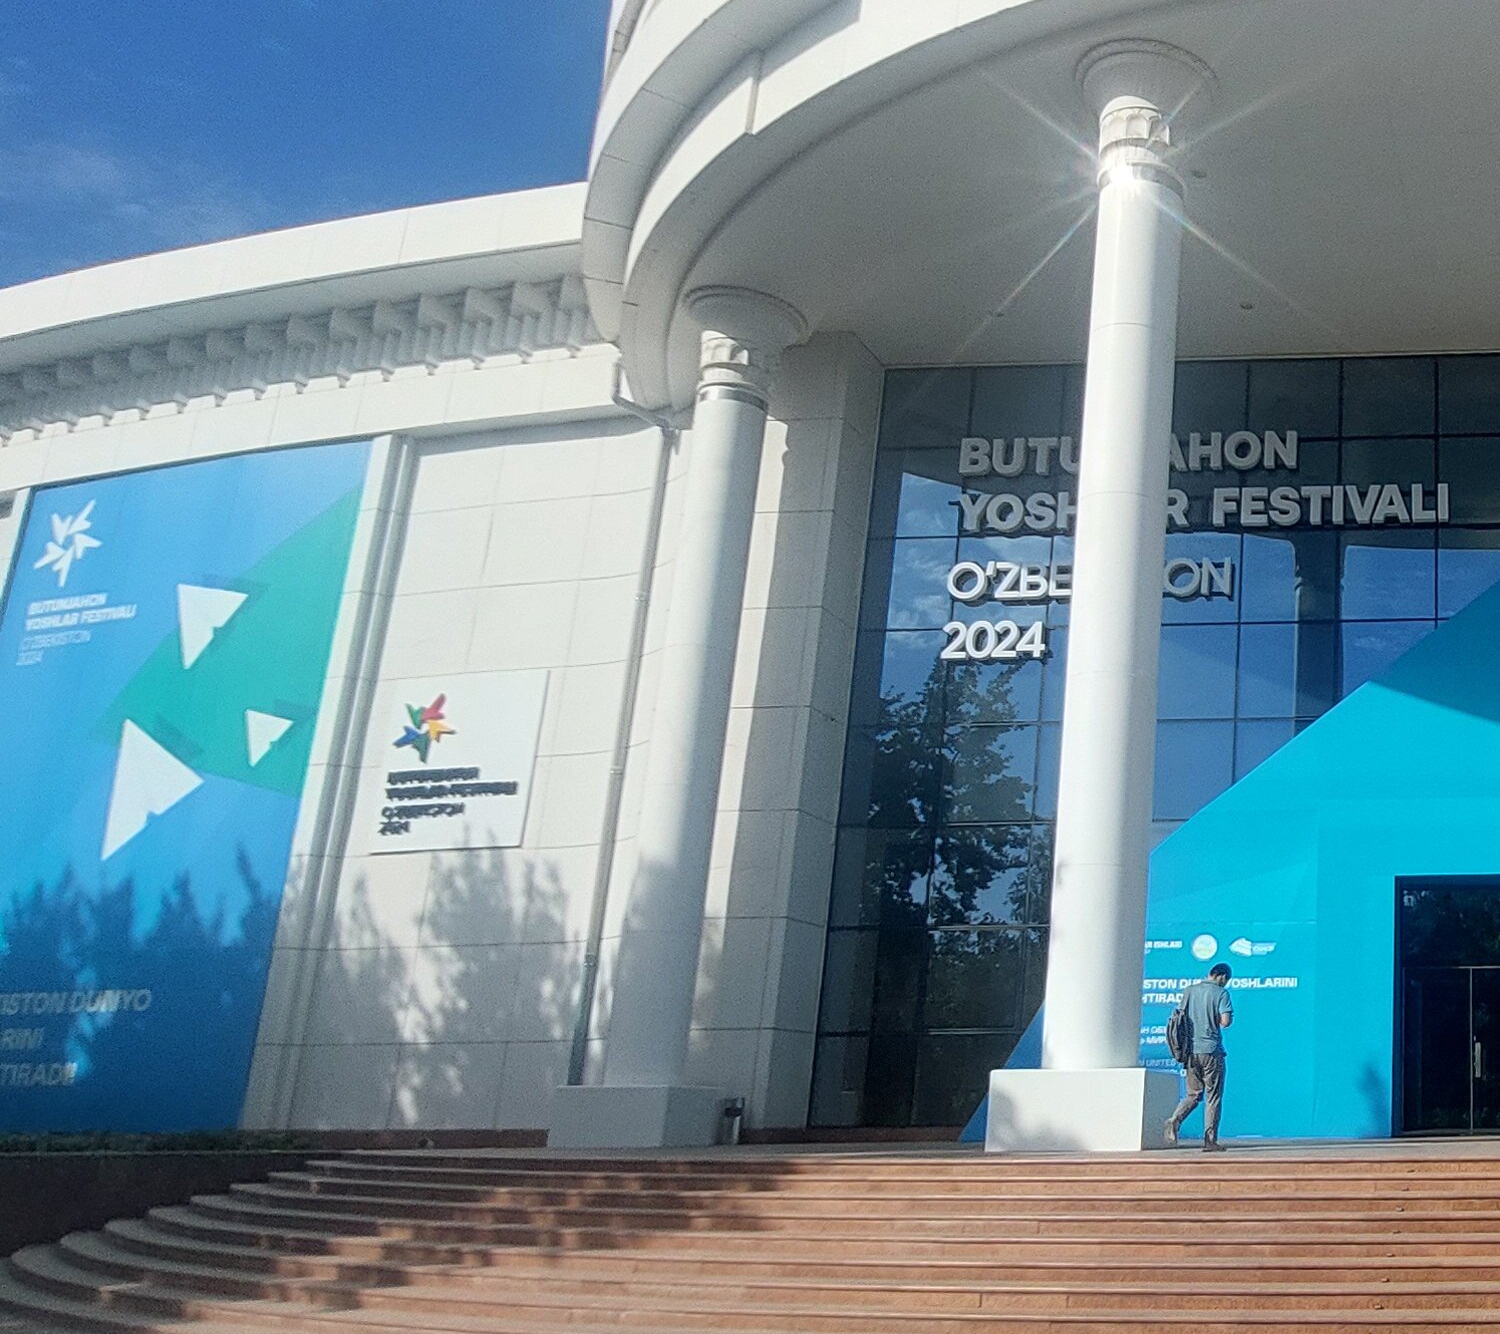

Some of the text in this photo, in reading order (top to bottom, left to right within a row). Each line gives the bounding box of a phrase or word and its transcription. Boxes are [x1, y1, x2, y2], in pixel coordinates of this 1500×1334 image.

[959, 431, 1298, 477] BUTUAHON
[959, 483, 1449, 533] YOSHR FESTIVALI
[941, 620, 1046, 660] 2024
